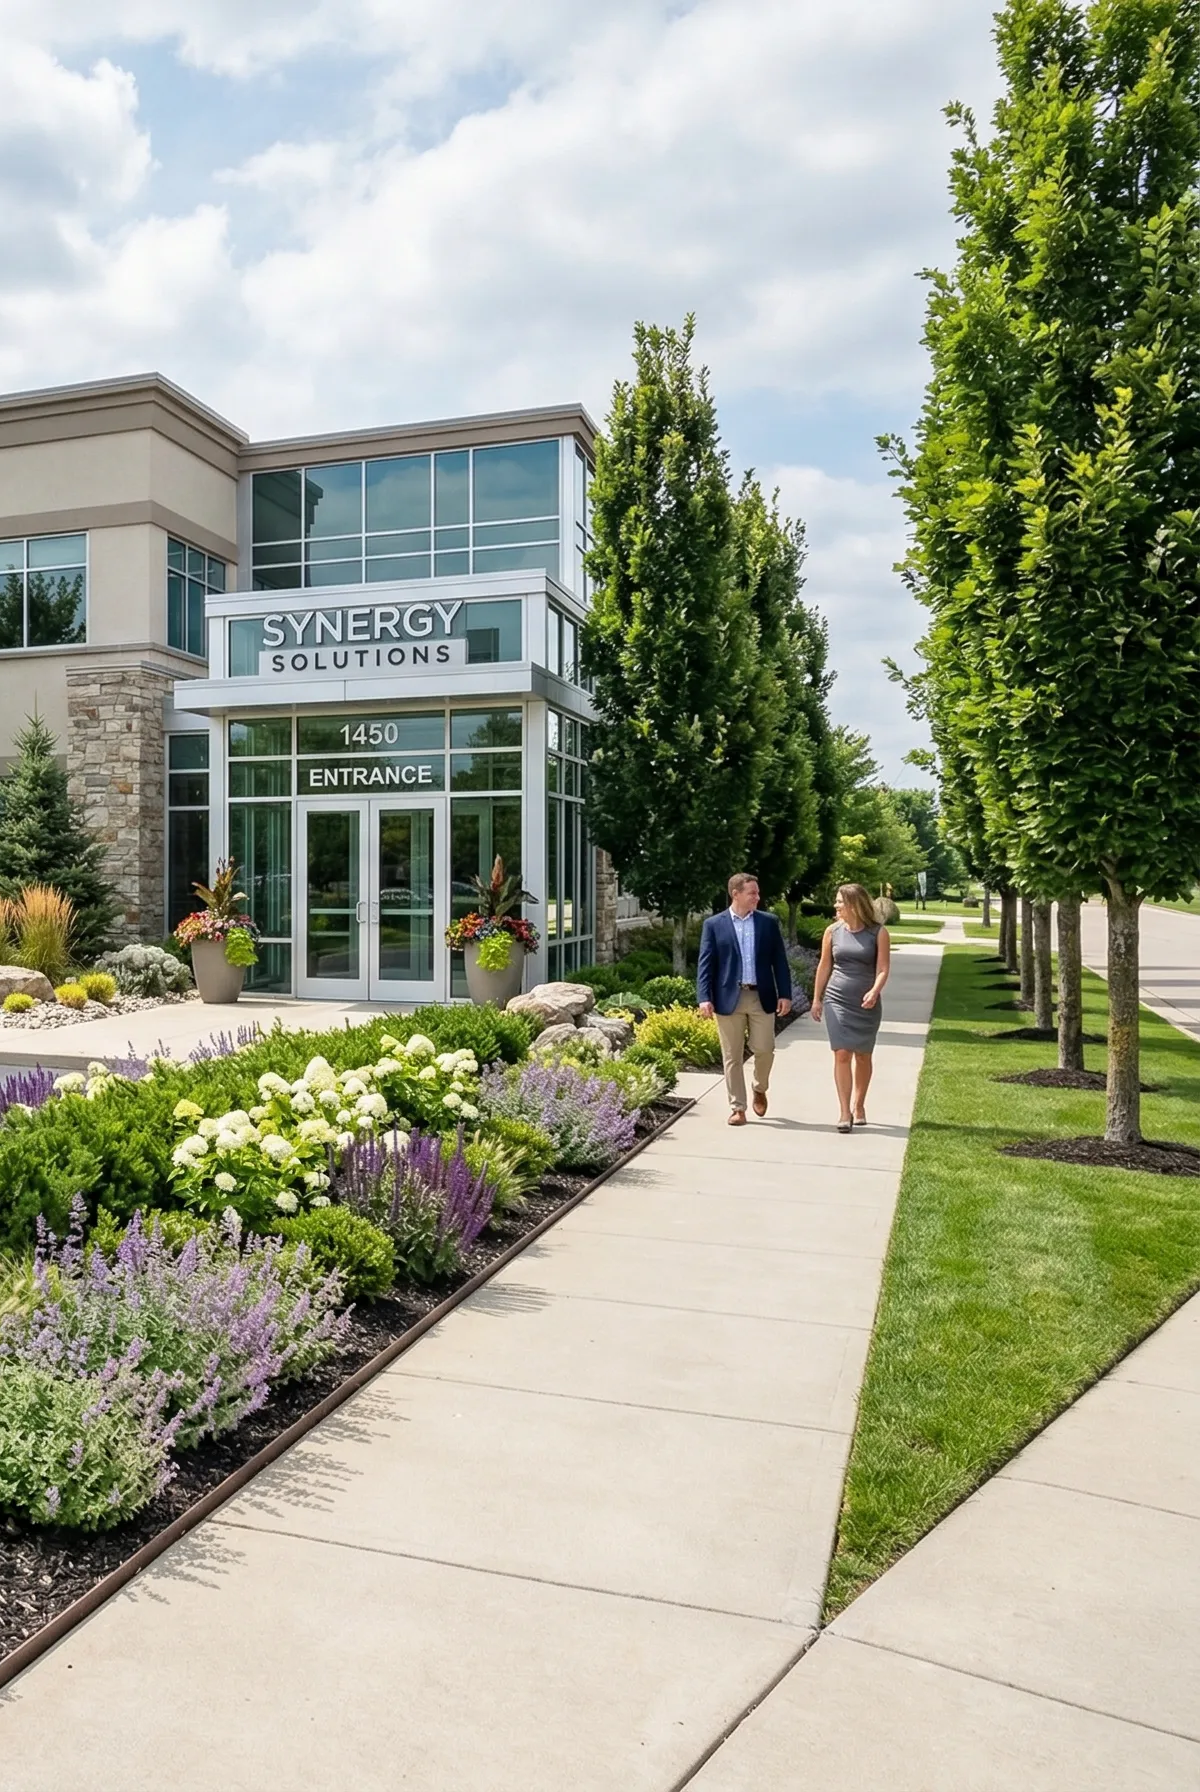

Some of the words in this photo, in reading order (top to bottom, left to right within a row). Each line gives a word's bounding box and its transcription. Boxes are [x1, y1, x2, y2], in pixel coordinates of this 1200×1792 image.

[262, 600, 464, 647] SYNERGY
[272, 645, 450, 672] SOLUTIONS
[340, 723, 399, 745] 1450
[309, 765, 433, 787] ENTRANCE
